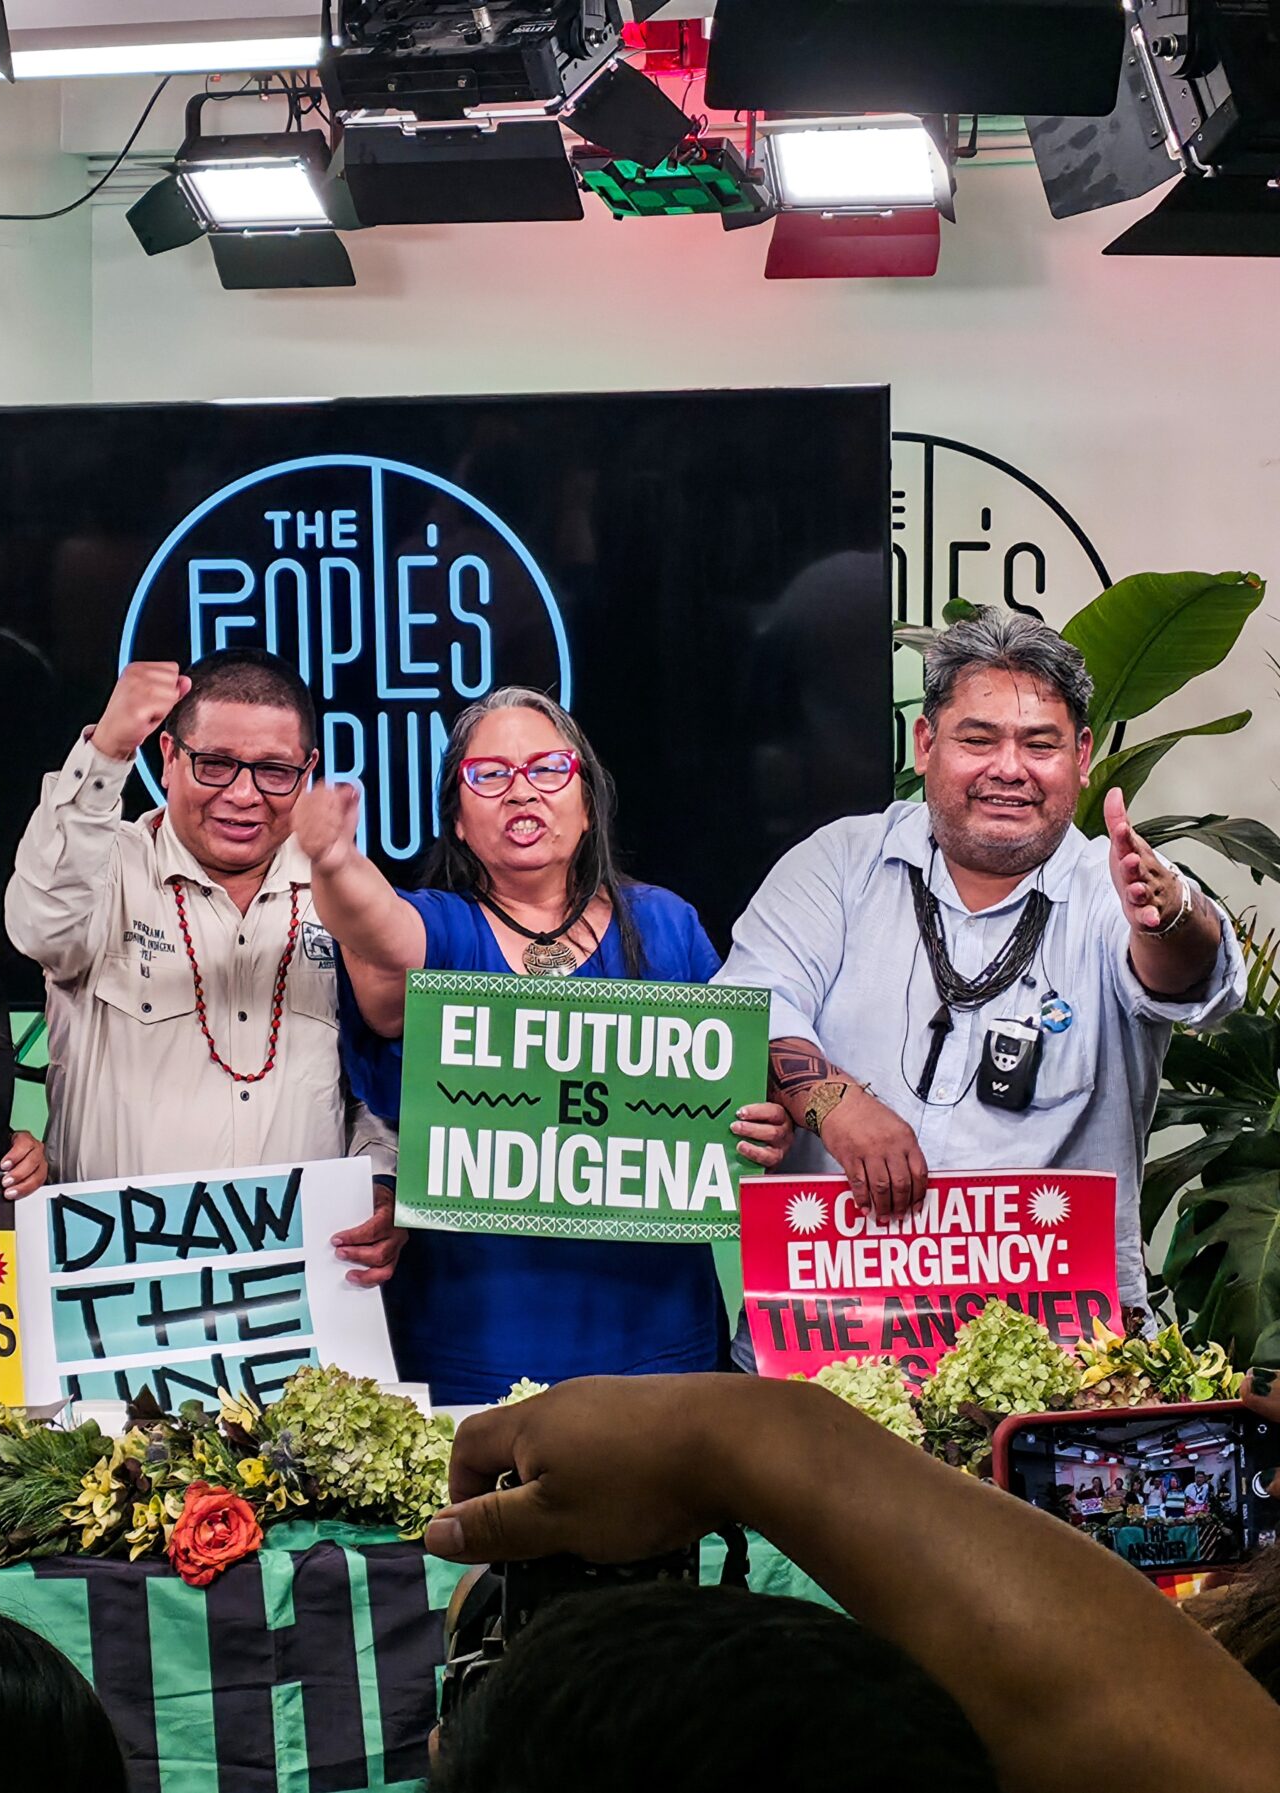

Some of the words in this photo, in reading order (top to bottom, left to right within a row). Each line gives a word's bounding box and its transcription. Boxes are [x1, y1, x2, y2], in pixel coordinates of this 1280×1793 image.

[263, 509, 358, 550] THE
[440, 1003, 501, 1069] EL
[513, 1009, 733, 1082] FUTURO
[557, 1080, 609, 1127] ES
[426, 1126, 737, 1212] INDÍGENA
[51, 1166, 303, 1273] DRAW
[787, 1234, 1069, 1292] EMERGENCY:
[56, 1260, 306, 1361] THE
[757, 1298, 869, 1352] THE
